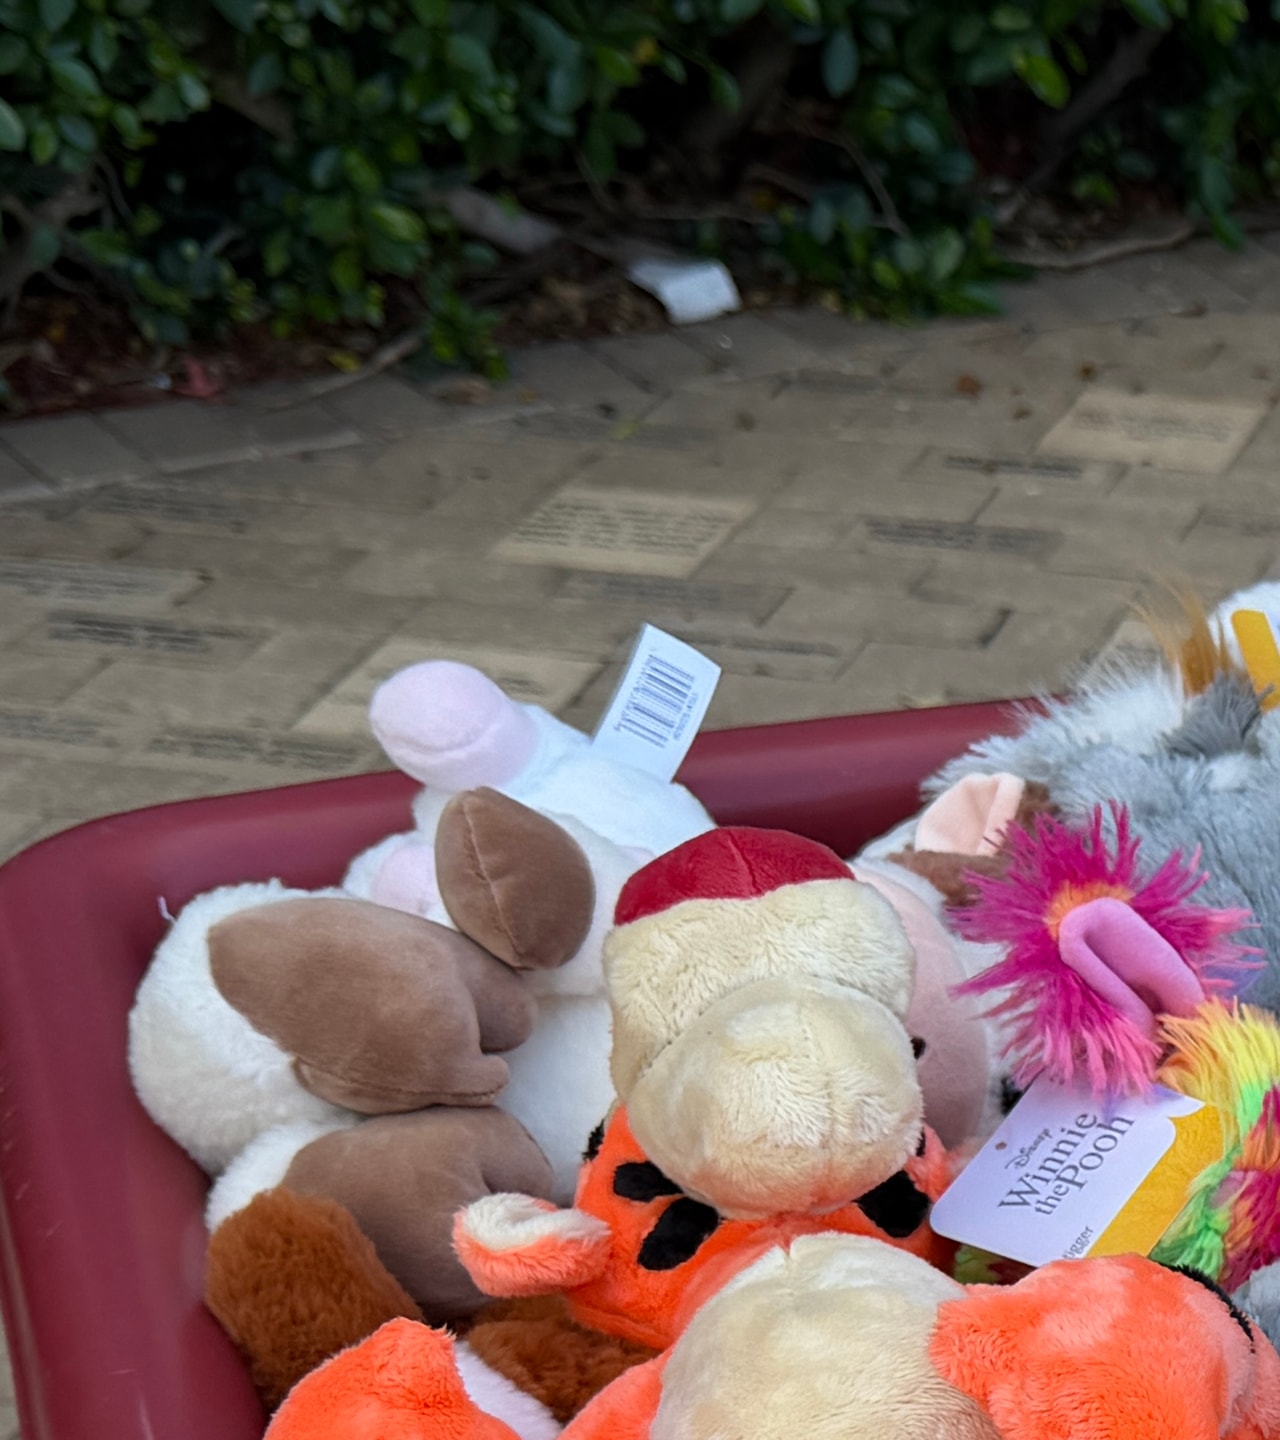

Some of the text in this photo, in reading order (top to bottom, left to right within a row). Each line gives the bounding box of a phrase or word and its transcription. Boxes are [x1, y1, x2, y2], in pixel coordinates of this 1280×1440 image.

[998, 1113, 1098, 1208] Winnie
[1034, 1115, 1135, 1216] the Pooh
